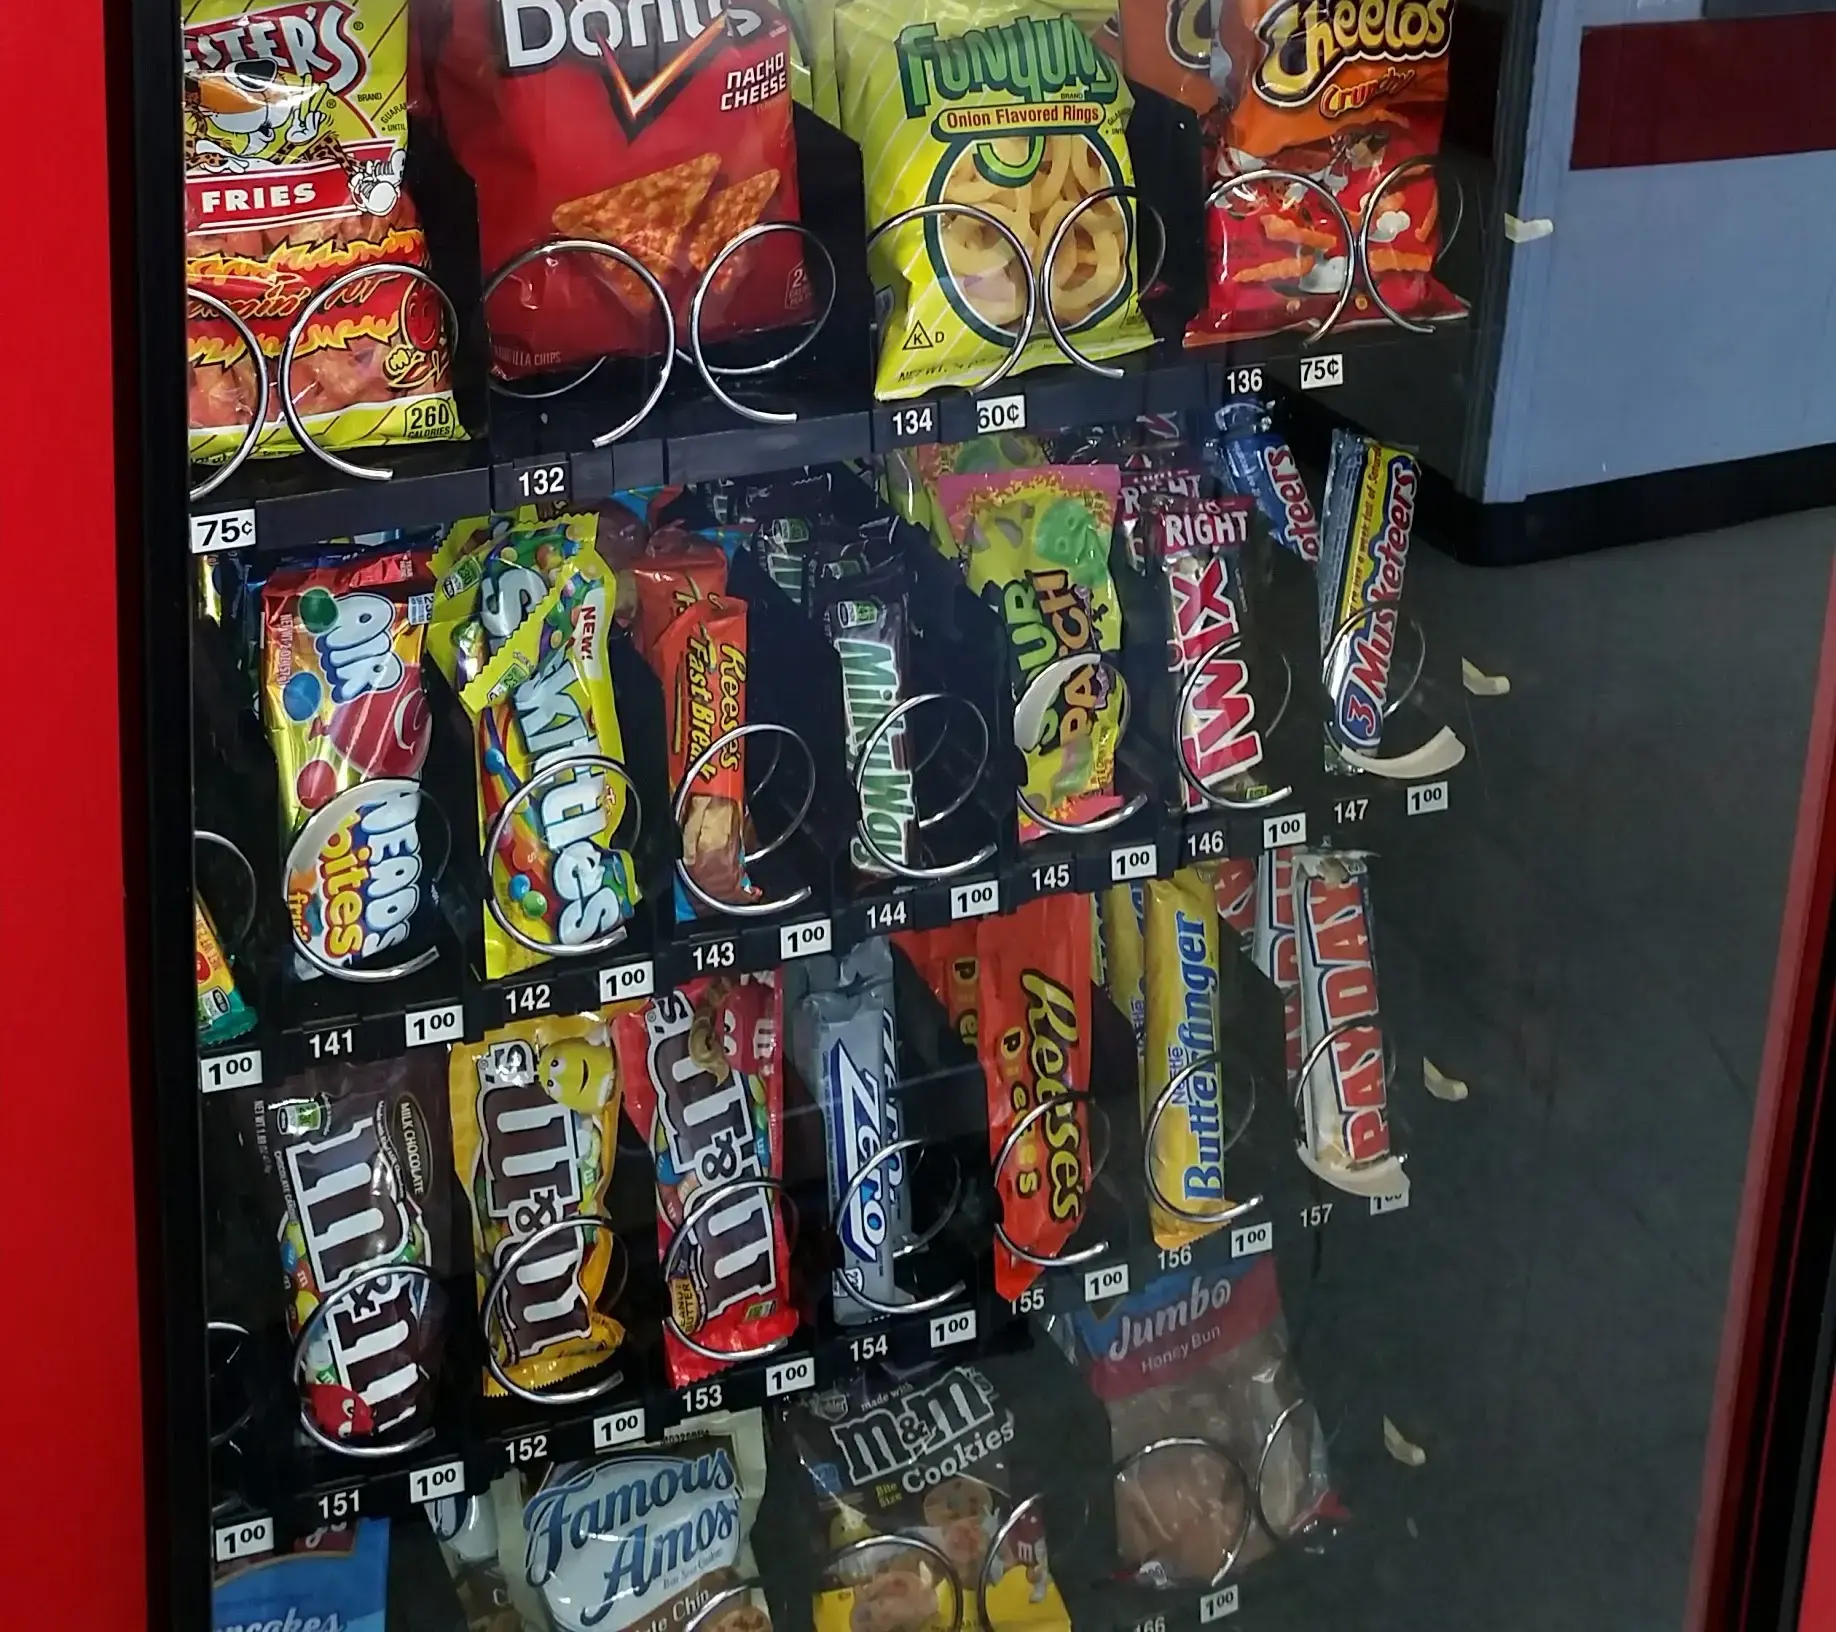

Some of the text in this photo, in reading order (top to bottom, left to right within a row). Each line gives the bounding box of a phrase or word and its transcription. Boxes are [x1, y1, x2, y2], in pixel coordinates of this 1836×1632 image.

[727, 51, 784, 90] NACHO
[357, 92, 382, 102] BRAND
[720, 70, 787, 111] CHEESE
[1319, 67, 1414, 119] Crunchy
[947, 108, 992, 129] Onion
[996, 104, 1059, 125] Flavored
[1063, 104, 1099, 124] Rings
[201, 183, 317, 215] FRIES
[1227, 368, 1263, 394] 136
[1301, 358, 1340, 383] 75¢
[408, 424, 451, 439] CALORIES
[411, 403, 449, 430] 260
[893, 408, 933, 435] 134
[979, 404, 1020, 429] 60¢
[519, 468, 565, 497] 132
[198, 517, 253, 547] 75¢
[1165, 510, 1248, 547] RIGHT
[1350, 458, 1418, 700] Musketeers
[581, 605, 596, 661] NEW!
[688, 635, 716, 703] Fast
[1004, 577, 1060, 756] SUR
[1032, 569, 1098, 747] PACH
[1169, 558, 1263, 812] TWIX
[719, 643, 748, 771] Reese's
[1347, 693, 1377, 735] 3
[511, 656, 618, 947] kittles
[1334, 799, 1369, 824] 147
[1187, 831, 1224, 856] 146
[319, 816, 363, 960] bites
[1031, 865, 1070, 891] 145
[866, 901, 907, 929] 144
[692, 942, 735, 969] 143
[505, 984, 551, 1014] 142
[1306, 874, 1391, 1165] PAYDAY
[308, 1030, 354, 1058] 141
[1176, 911, 1224, 1200] Butterfinger
[1020, 968, 1083, 1223] Reese's
[400, 1102, 424, 1195] MILK CHOCOLATE
[1301, 1204, 1333, 1227] 157
[1157, 1248, 1192, 1270] 156
[1011, 1287, 1045, 1315] 155
[1108, 1275, 1232, 1362] Jumbo
[849, 1336, 889, 1362] 154
[1140, 1321, 1222, 1375] Honey Bun
[681, 1387, 723, 1412] 153
[861, 1395, 890, 1412] made
[504, 1437, 548, 1463] 152
[900, 1417, 1016, 1495] Cookies
[318, 1490, 361, 1518] 151
[524, 1447, 737, 1586] Famous
[580, 1498, 739, 1625] Amos
[672, 1588, 710, 1620] Chip
